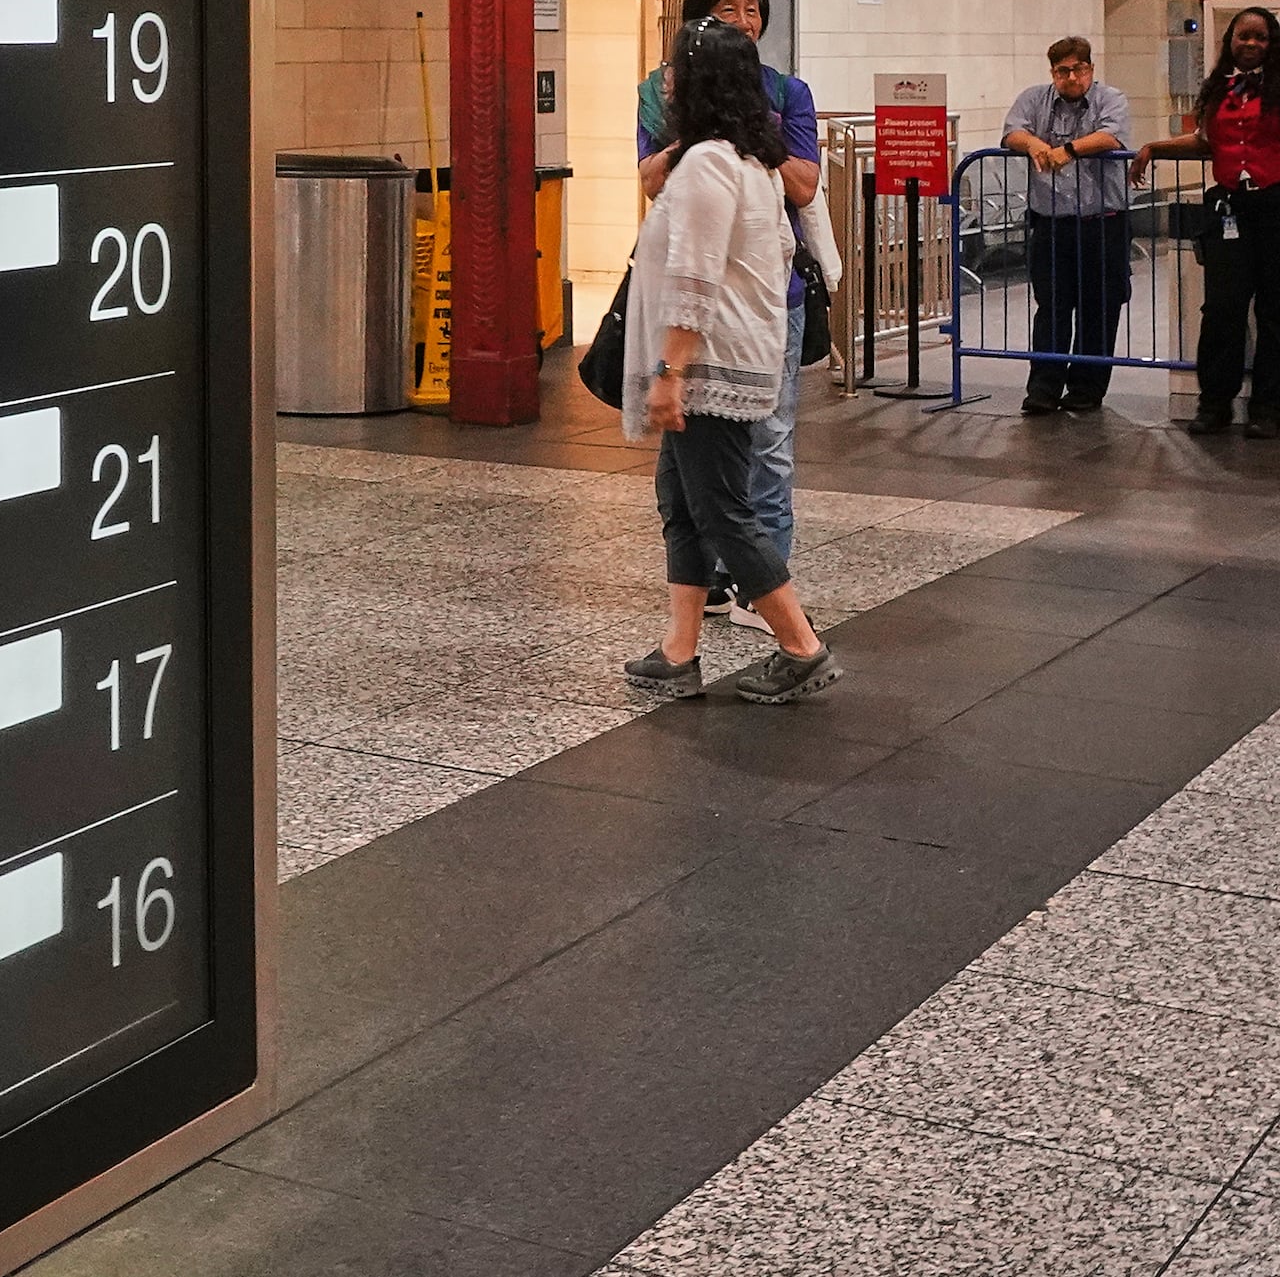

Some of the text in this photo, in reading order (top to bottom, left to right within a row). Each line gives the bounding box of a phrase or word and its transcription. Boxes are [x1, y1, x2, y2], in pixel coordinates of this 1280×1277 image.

[93, 13, 168, 103] 19
[884, 118, 909, 126] Please
[90, 223, 170, 321] 20
[91, 435, 159, 540] 21
[97, 644, 171, 750] 17
[98, 857, 174, 967] 16
